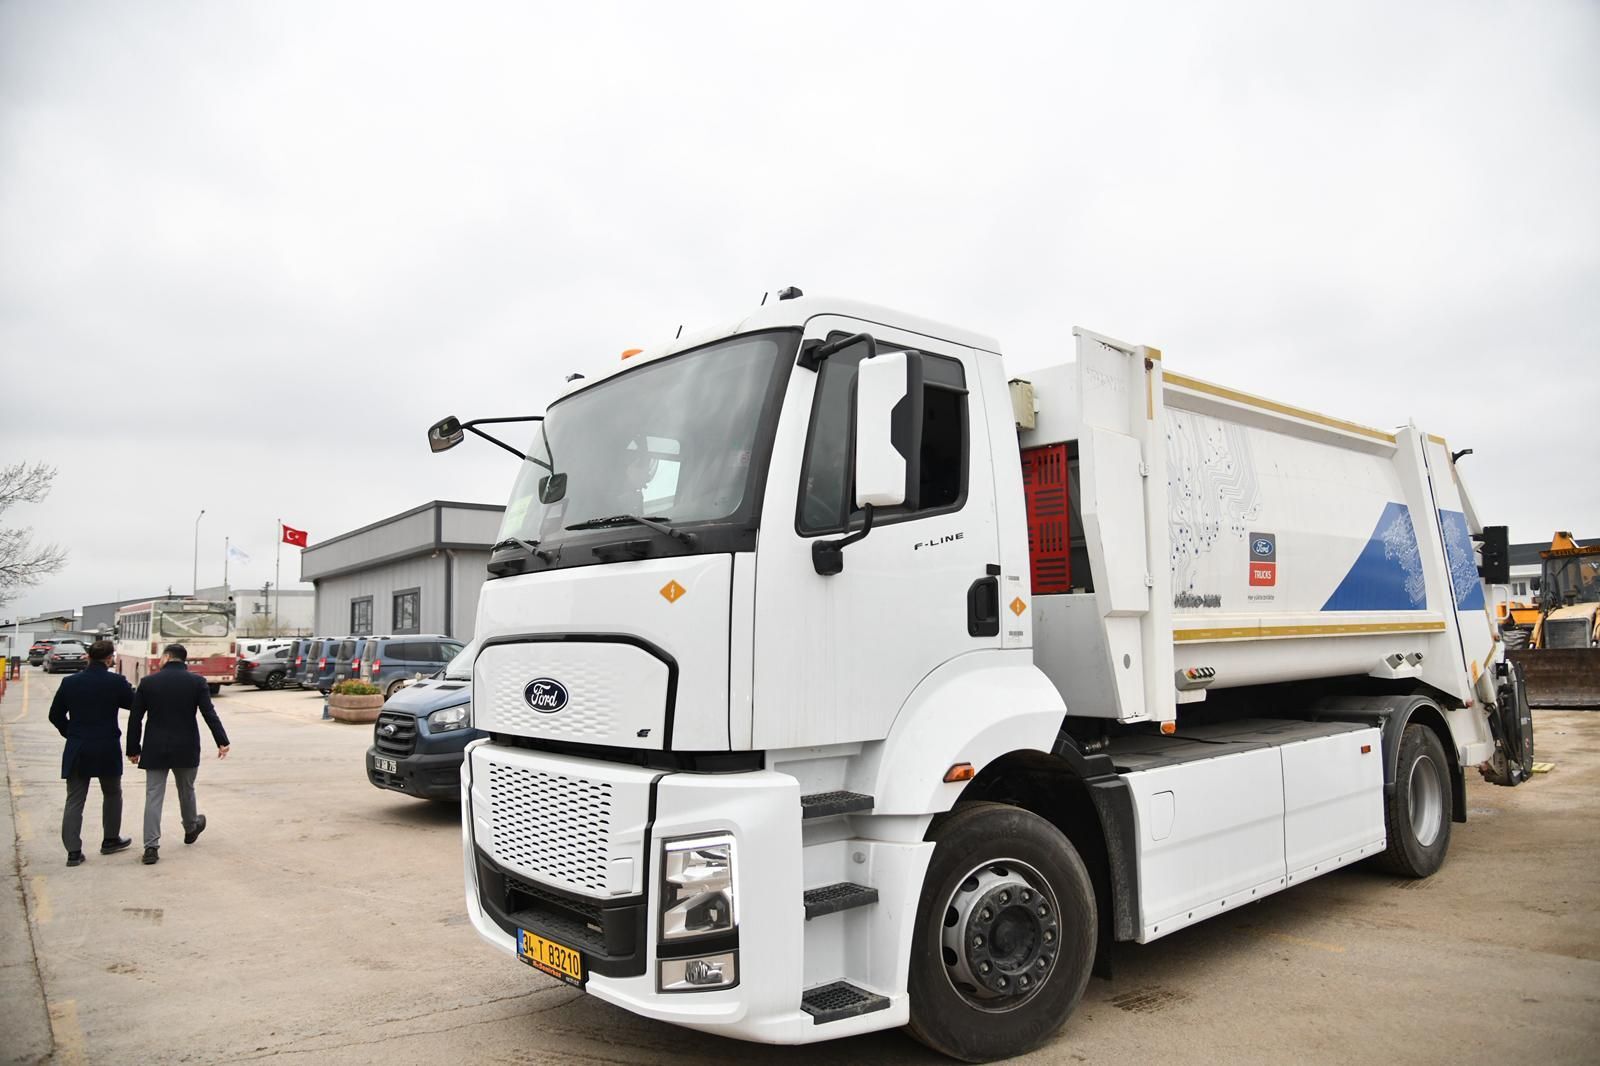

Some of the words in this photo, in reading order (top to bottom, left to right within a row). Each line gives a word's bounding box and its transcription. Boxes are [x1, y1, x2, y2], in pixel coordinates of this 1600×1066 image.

[914, 532, 964, 551] F-LINE
[1254, 570, 1272, 580] TRUCKS
[531, 683, 559, 707] Ford
[523, 933, 534, 957] 34
[538, 940, 544, 961] T
[548, 944, 580, 976] 83210
